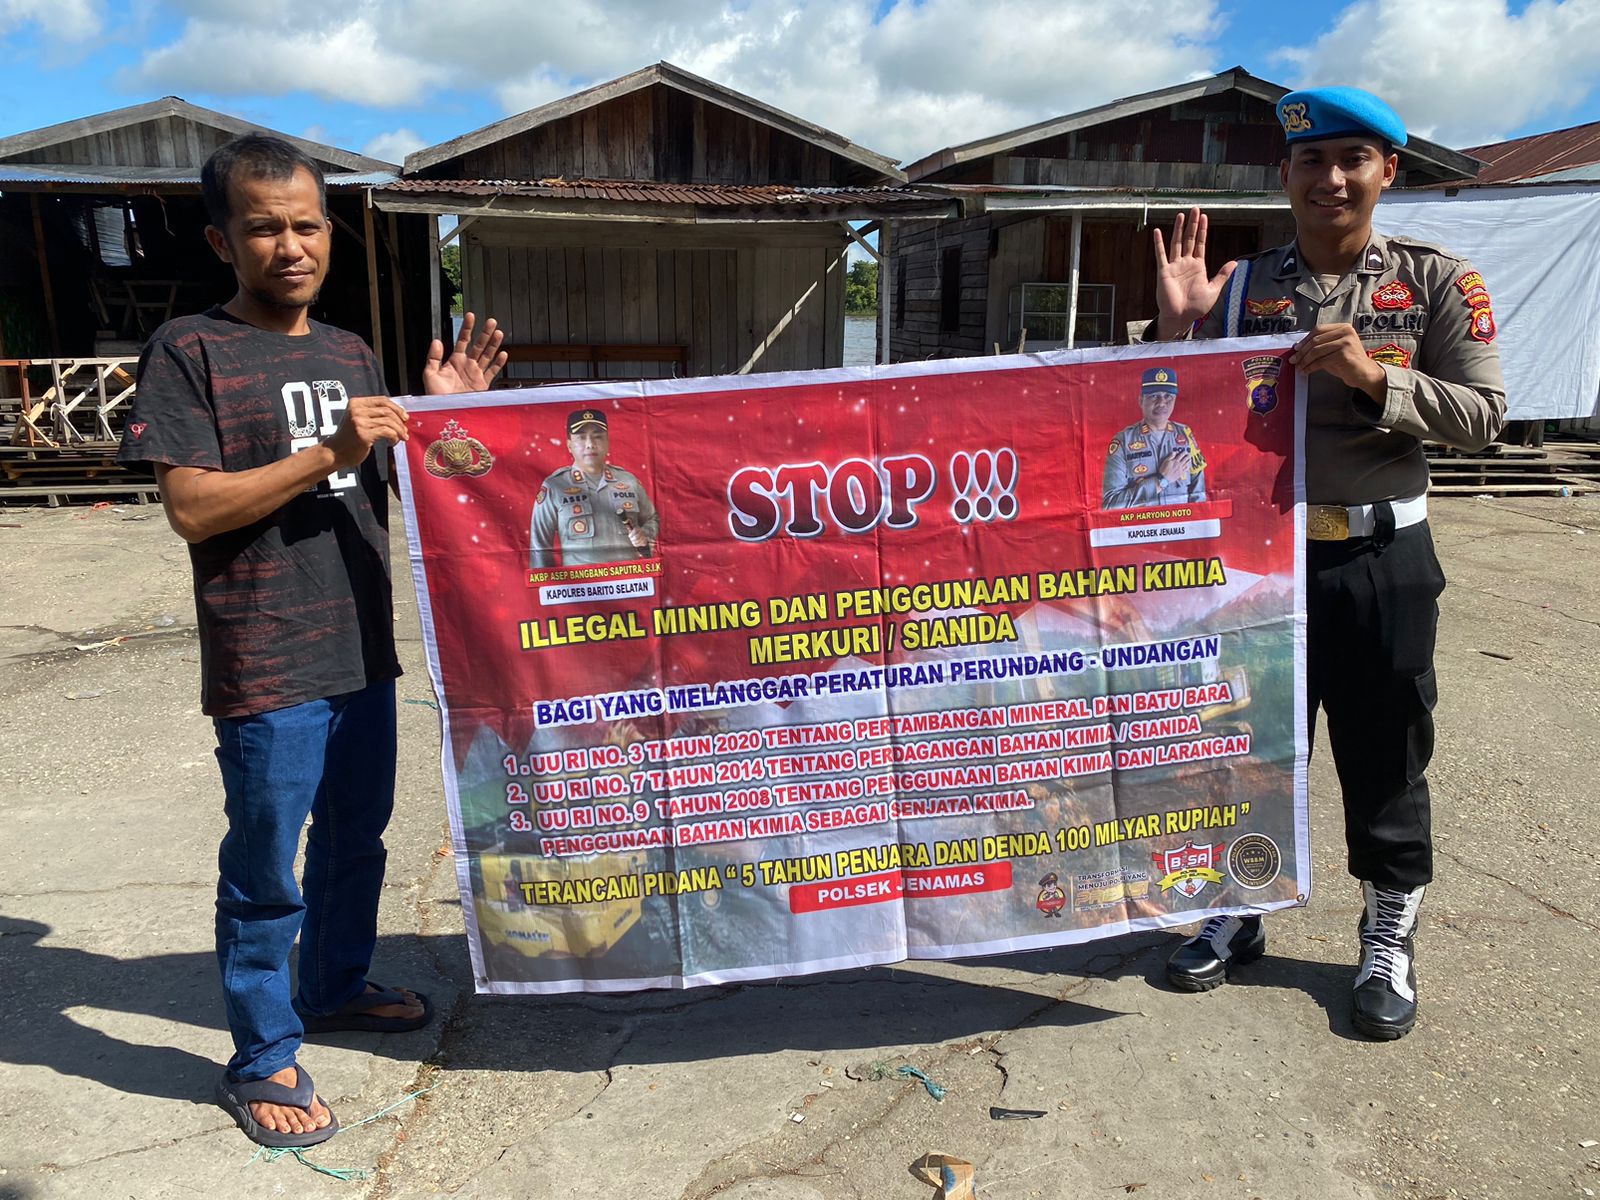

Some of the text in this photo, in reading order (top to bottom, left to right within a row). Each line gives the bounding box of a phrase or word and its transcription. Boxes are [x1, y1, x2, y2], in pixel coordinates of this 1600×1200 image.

[1359, 313, 1423, 330] POLRI
[281, 380, 349, 438] OP
[562, 494, 588, 504] ASEP
[613, 491, 635, 499] POLRI
[728, 447, 1020, 542] STOP !!!
[1120, 508, 1192, 521] AKP HARYONO NOTO
[1127, 526, 1185, 539] KAPOLSEK JENAMAS
[529, 573, 548, 582] AKBP
[551, 571, 568, 581] ASEP
[570, 567, 609, 579] BANGBANG
[610, 564, 644, 577] SAPUTRA,
[546, 581, 649, 600] KAPOLRES BARITO SELATAN
[520, 557, 1226, 650] ILLEGAL MINING DAN PENGGUNAAN BAHAN KIMIA
[749, 612, 1017, 665] MERKURI / SIANIDA
[537, 700, 592, 726] BAGI
[600, 691, 662, 719] YANG
[669, 678, 808, 709] MELANGGAR
[815, 663, 945, 695] PERATURAN
[950, 651, 1084, 683] PERUNDANG
[1102, 637, 1219, 669] UNDANGAN
[504, 682, 1231, 776] 1. UU RI NO. 3 TAHUN 2020 TENTANG PERTAMBANGAN MINERAL DAN BATU BARA
[507, 714, 1200, 803] 2. UU RI NO. 7 TAHUN 2014 TENTANG PERDAGANGAN BAHAN KIMIA / SIANIDA
[510, 734, 1250, 831] 3. UU RI NO. 9 TAHUN 2008 TENTANG PENGGUNAAN BAHAN KIMIA DAN LARANGAN
[541, 790, 1033, 857] PENGGUNAAN BAHAN KIMIA SEBAGAI SENJATA KIMIA.
[520, 872, 641, 907] TERANCAM
[644, 864, 721, 897] PIDANA
[742, 865, 755, 888] 5
[759, 855, 832, 885] TAHUN
[837, 841, 931, 876] PENJARA
[936, 836, 978, 865] DAN
[983, 830, 1051, 863] DENDA
[1056, 826, 1091, 852] 100
[1095, 815, 1160, 846] MILYAR
[1165, 803, 1237, 834] RUPIAH
[1078, 881, 1108, 890] MENUJU
[1127, 873, 1147, 881] YANG
[817, 871, 985, 904] POLSEK JENAMAS
